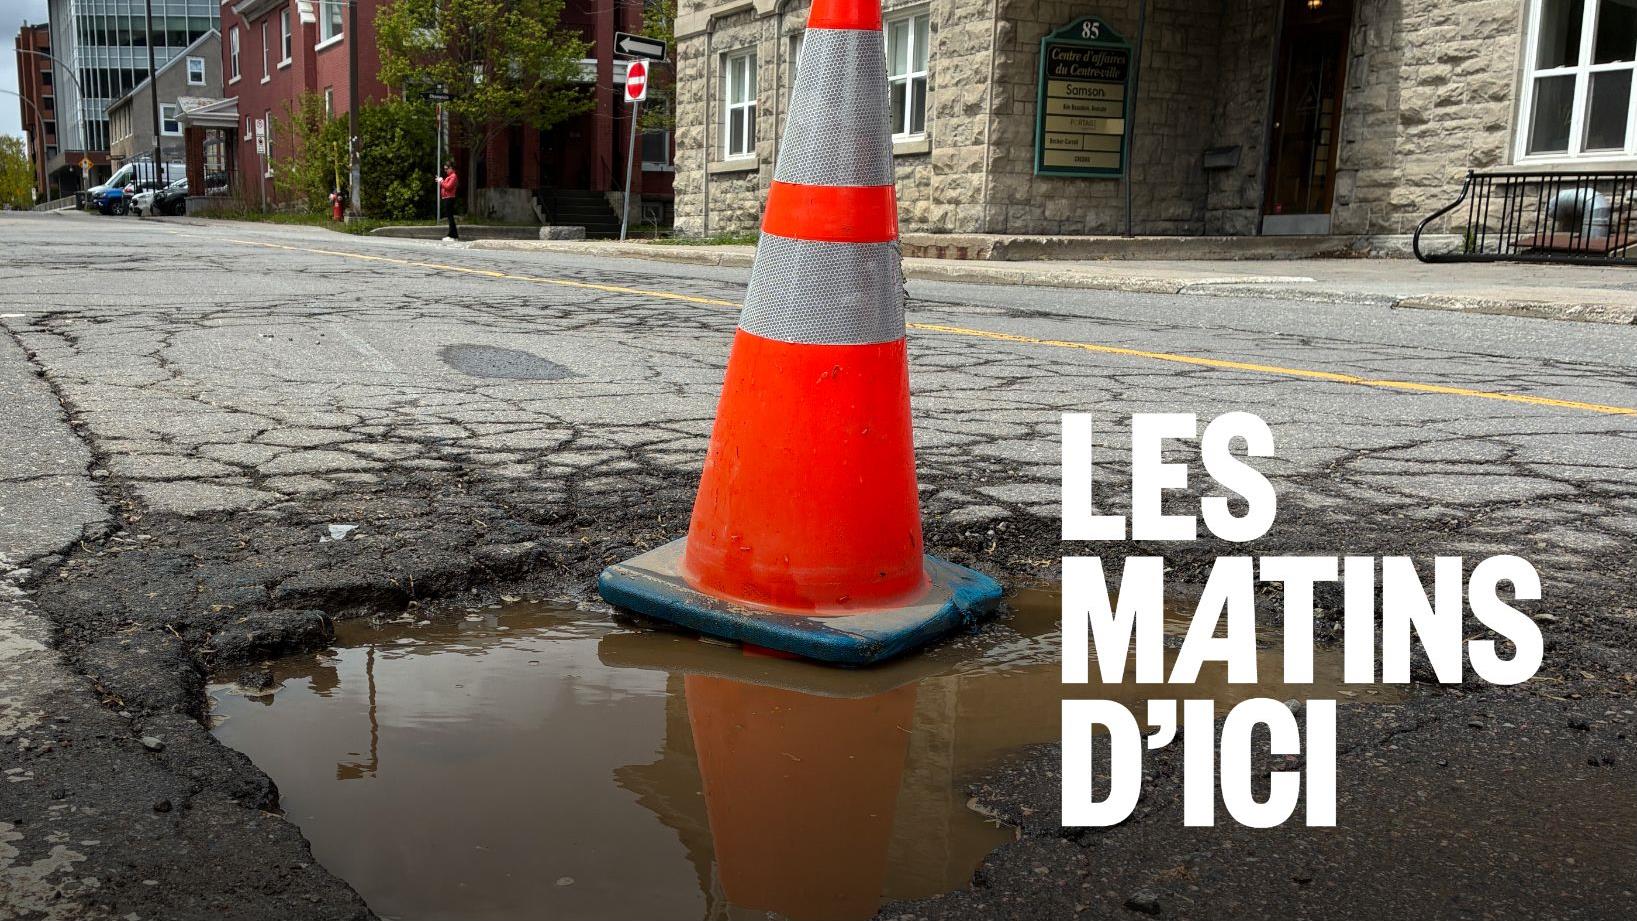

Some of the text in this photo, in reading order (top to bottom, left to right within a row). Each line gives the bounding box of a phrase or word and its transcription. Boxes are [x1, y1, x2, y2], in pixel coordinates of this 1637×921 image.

[1081, 21, 1100, 39] 85
[1052, 48, 1081, 61] Centre
[1055, 63, 1068, 75] du
[1066, 84, 1105, 97] Samson
